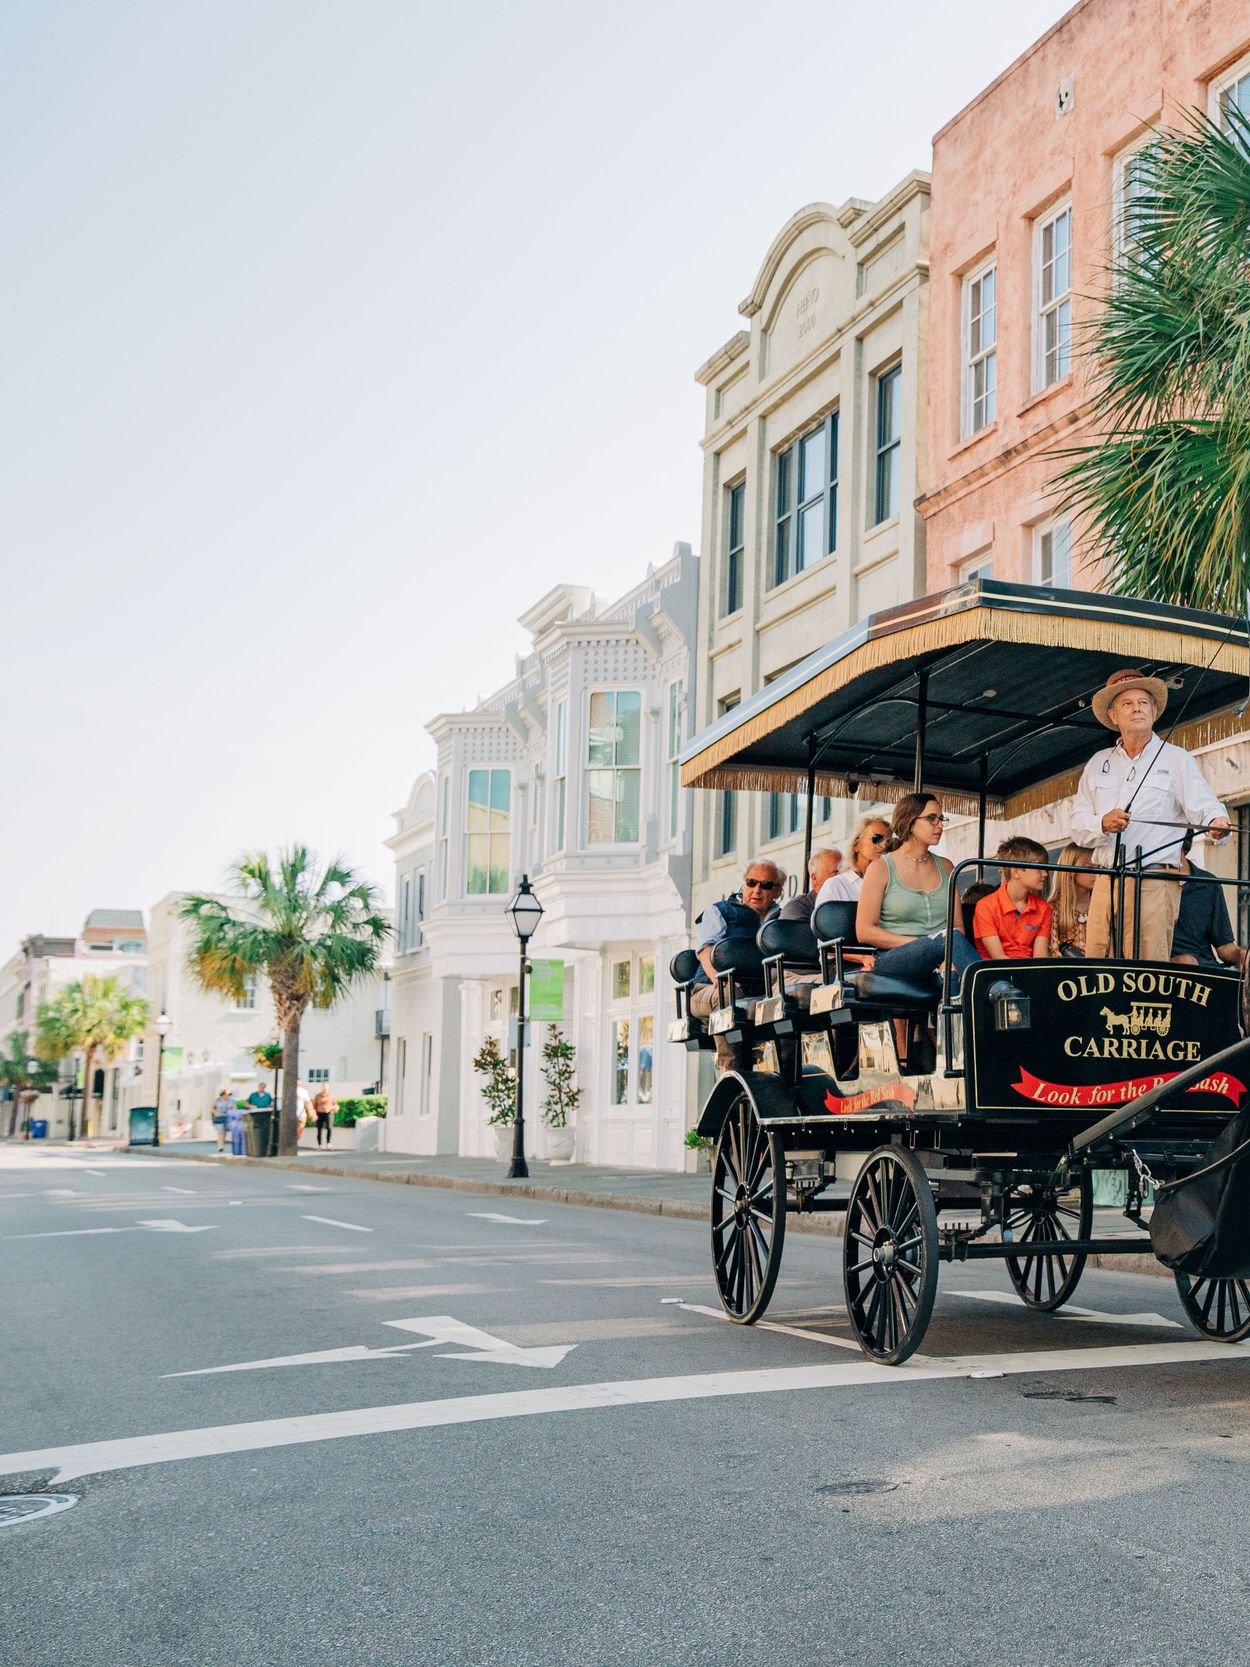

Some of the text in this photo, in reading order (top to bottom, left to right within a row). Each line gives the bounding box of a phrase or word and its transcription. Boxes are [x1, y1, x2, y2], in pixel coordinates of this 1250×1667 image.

[1057, 972, 1213, 1007] OLD SOUTH
[1063, 1036, 1202, 1061] CARRIAGE
[1032, 1082, 1082, 1104] Look
[1088, 1085, 1115, 1104] for
[1120, 1080, 1147, 1100] the
[1190, 1075, 1230, 1094] ash
